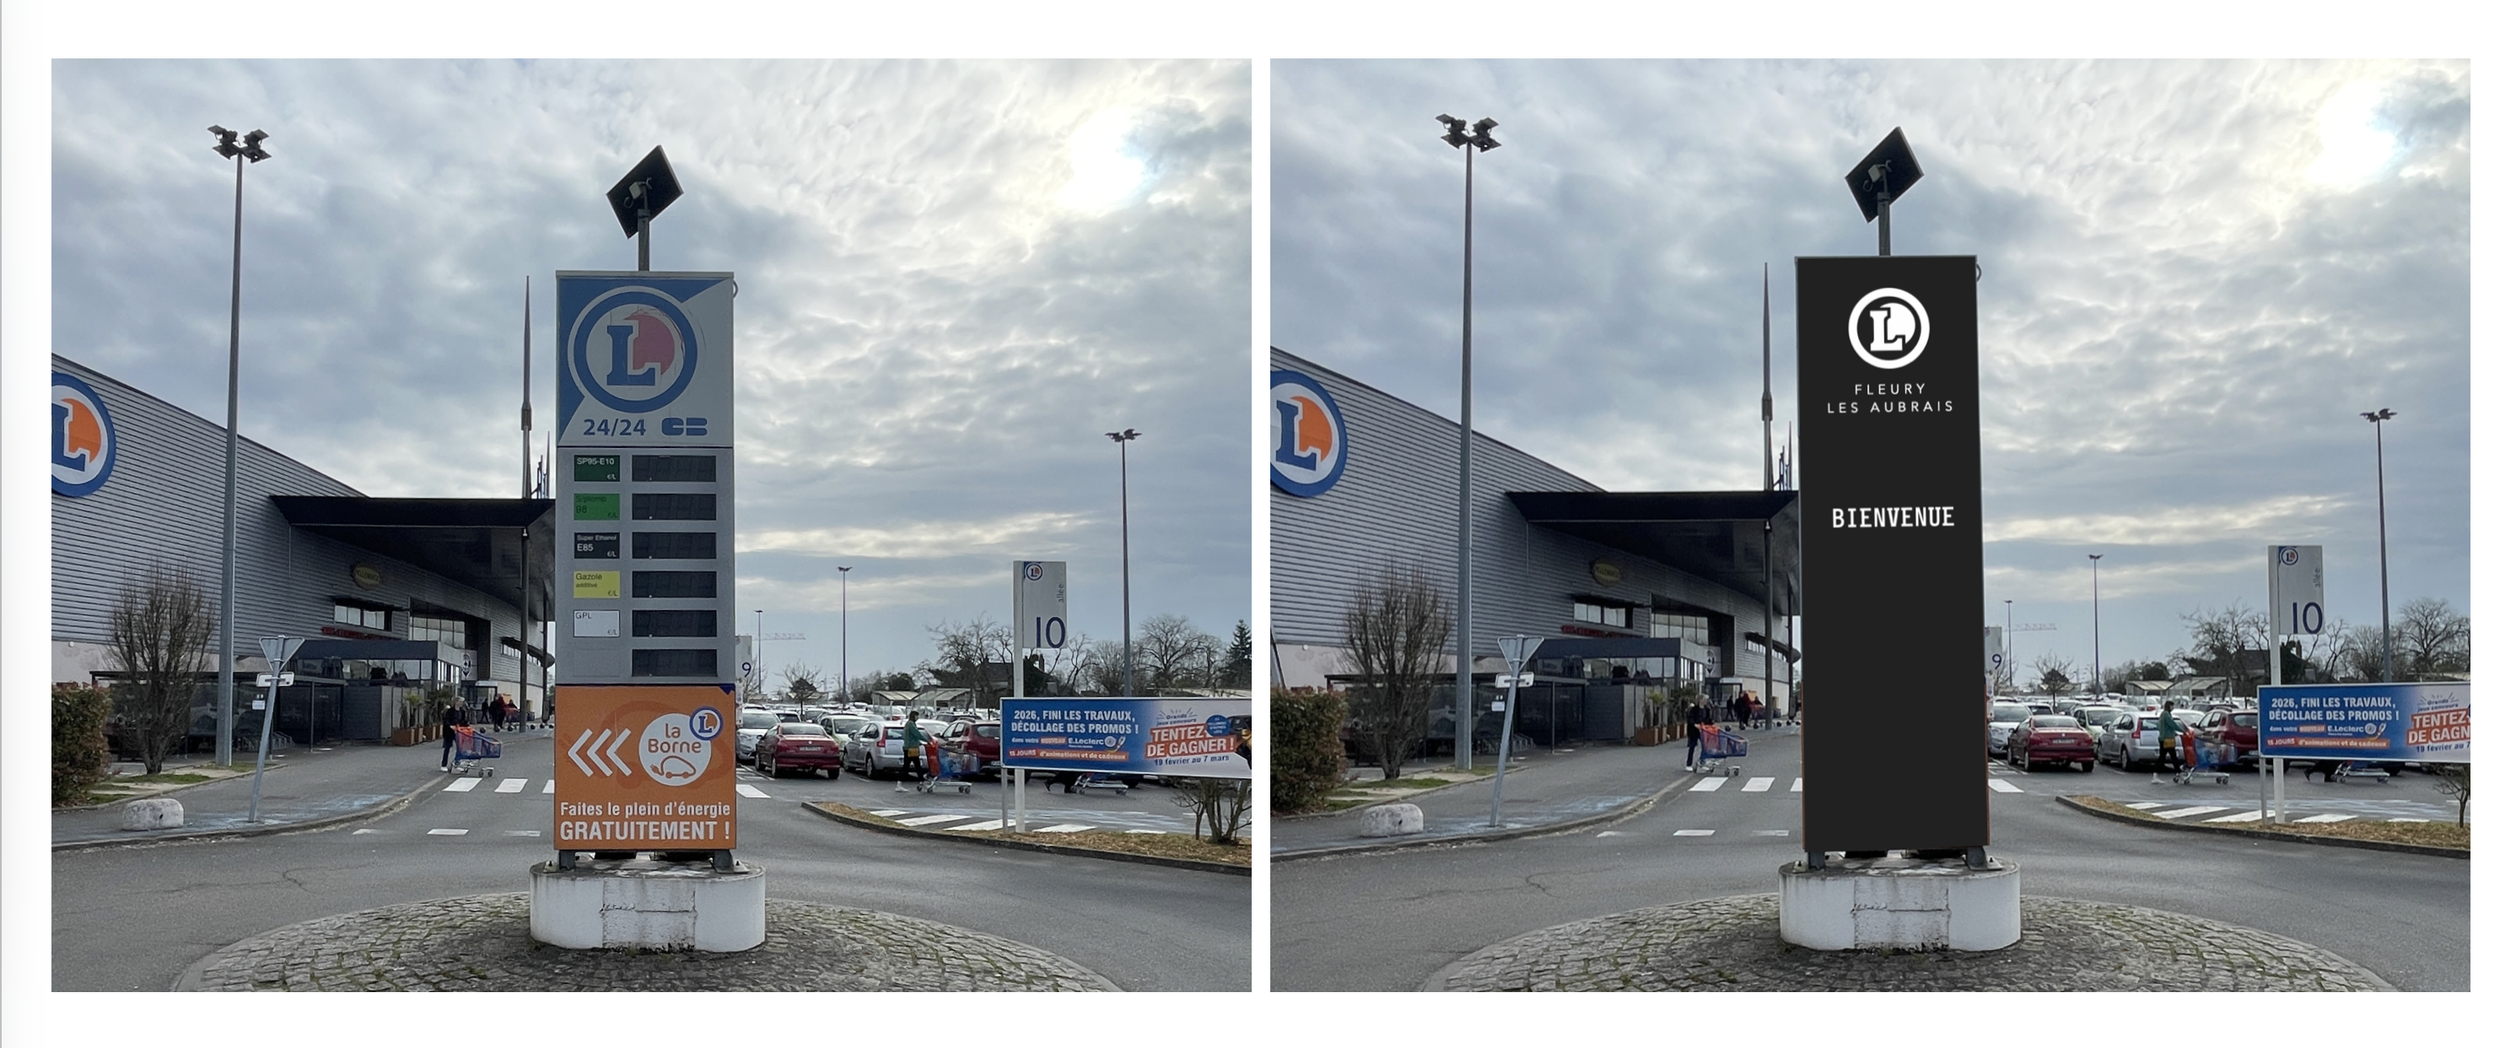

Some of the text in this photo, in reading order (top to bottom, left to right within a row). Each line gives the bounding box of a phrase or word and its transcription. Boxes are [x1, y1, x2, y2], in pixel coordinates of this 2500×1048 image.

[1854, 383, 1925, 396] FLEURY
[1827, 400, 1953, 414] LES AUBRAIS
[583, 418, 646, 437] 24/24
[575, 505, 587, 514] 98
[1832, 506, 1955, 528] BIENVENUE
[577, 543, 594, 552] E85
[2293, 602, 2323, 634] 10
[1036, 616, 1066, 648] 10
[1992, 653, 2002, 670] 9
[741, 662, 752, 678] 9
[2271, 697, 2395, 709] 2026, FINI LES TRAVAUX,
[1014, 710, 1135, 722] 2026, FINI LES TRAVAUX,
[2269, 708, 2399, 721] DÉCOLLAGE DES PROMOS !
[2413, 711, 2467, 729] TENTEZ
[665, 723, 680, 738] la
[1011, 720, 1139, 734] DÉCOLLAGE DES PROMOS !
[1152, 725, 1205, 742] TENTEZ
[2327, 725, 2364, 733] E.Leclerc
[1068, 737, 1104, 745] E.Leclerc
[2408, 730, 2427, 743] DE
[648, 738, 702, 754] Borne
[1147, 737, 1234, 757] DE GAGNER !
[2427, 743, 2452, 752] février
[1165, 757, 1190, 765] février
[560, 802, 730, 819] Faites le plein d'énergie
[560, 821, 730, 840] GRATUITEMENT !
